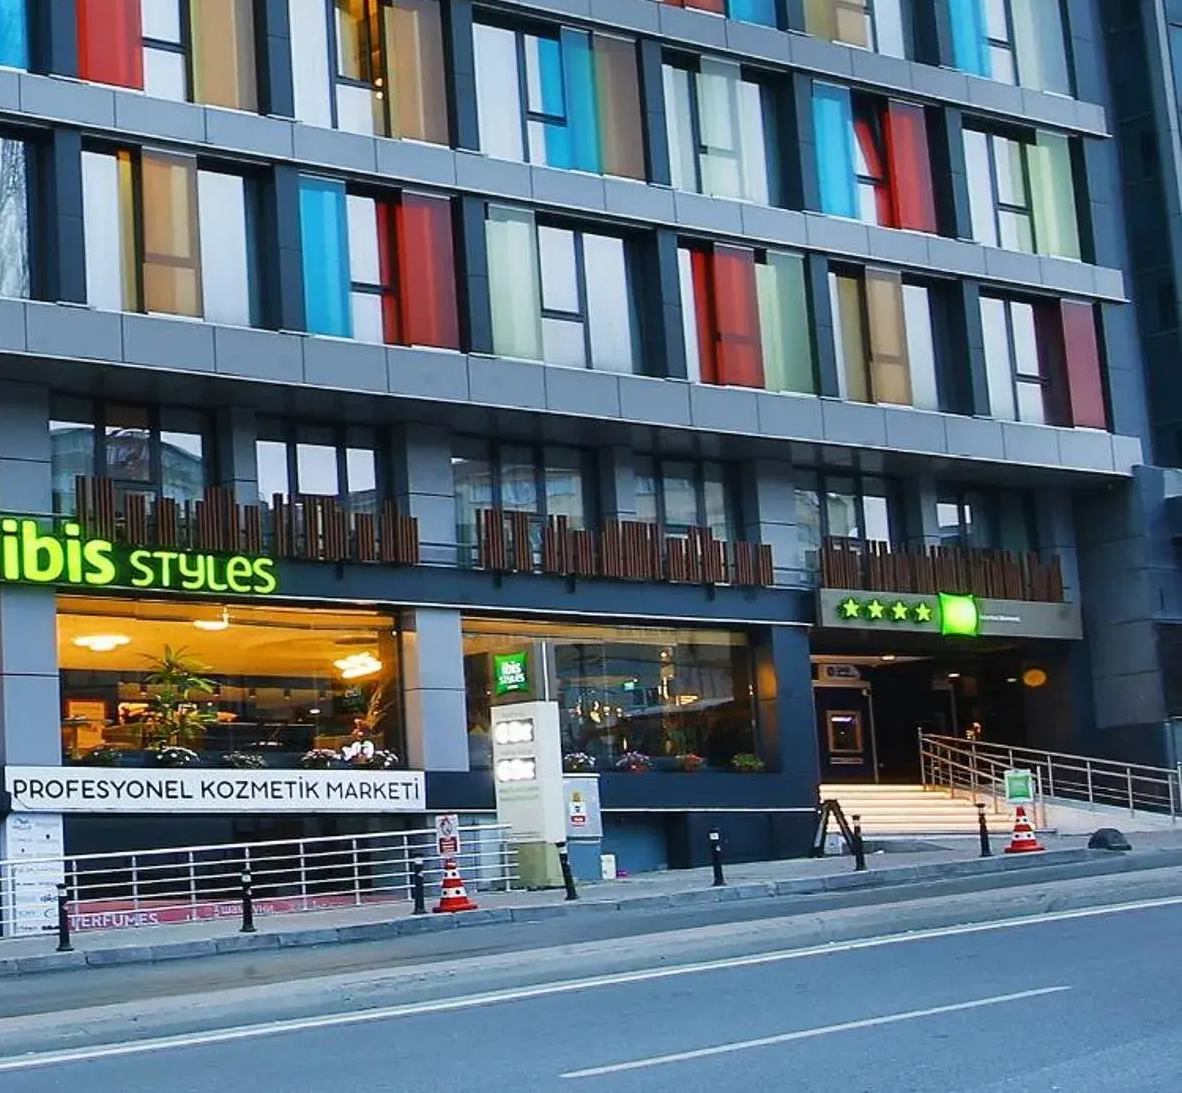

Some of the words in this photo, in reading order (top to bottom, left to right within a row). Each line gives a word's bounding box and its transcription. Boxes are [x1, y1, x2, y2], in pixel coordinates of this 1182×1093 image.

[2, 519, 116, 584] ibis
[13, 779, 193, 799] PROFESYONEL
[201, 776, 319, 800] KOZMETİK
[326, 777, 419, 800] MARKETİ
